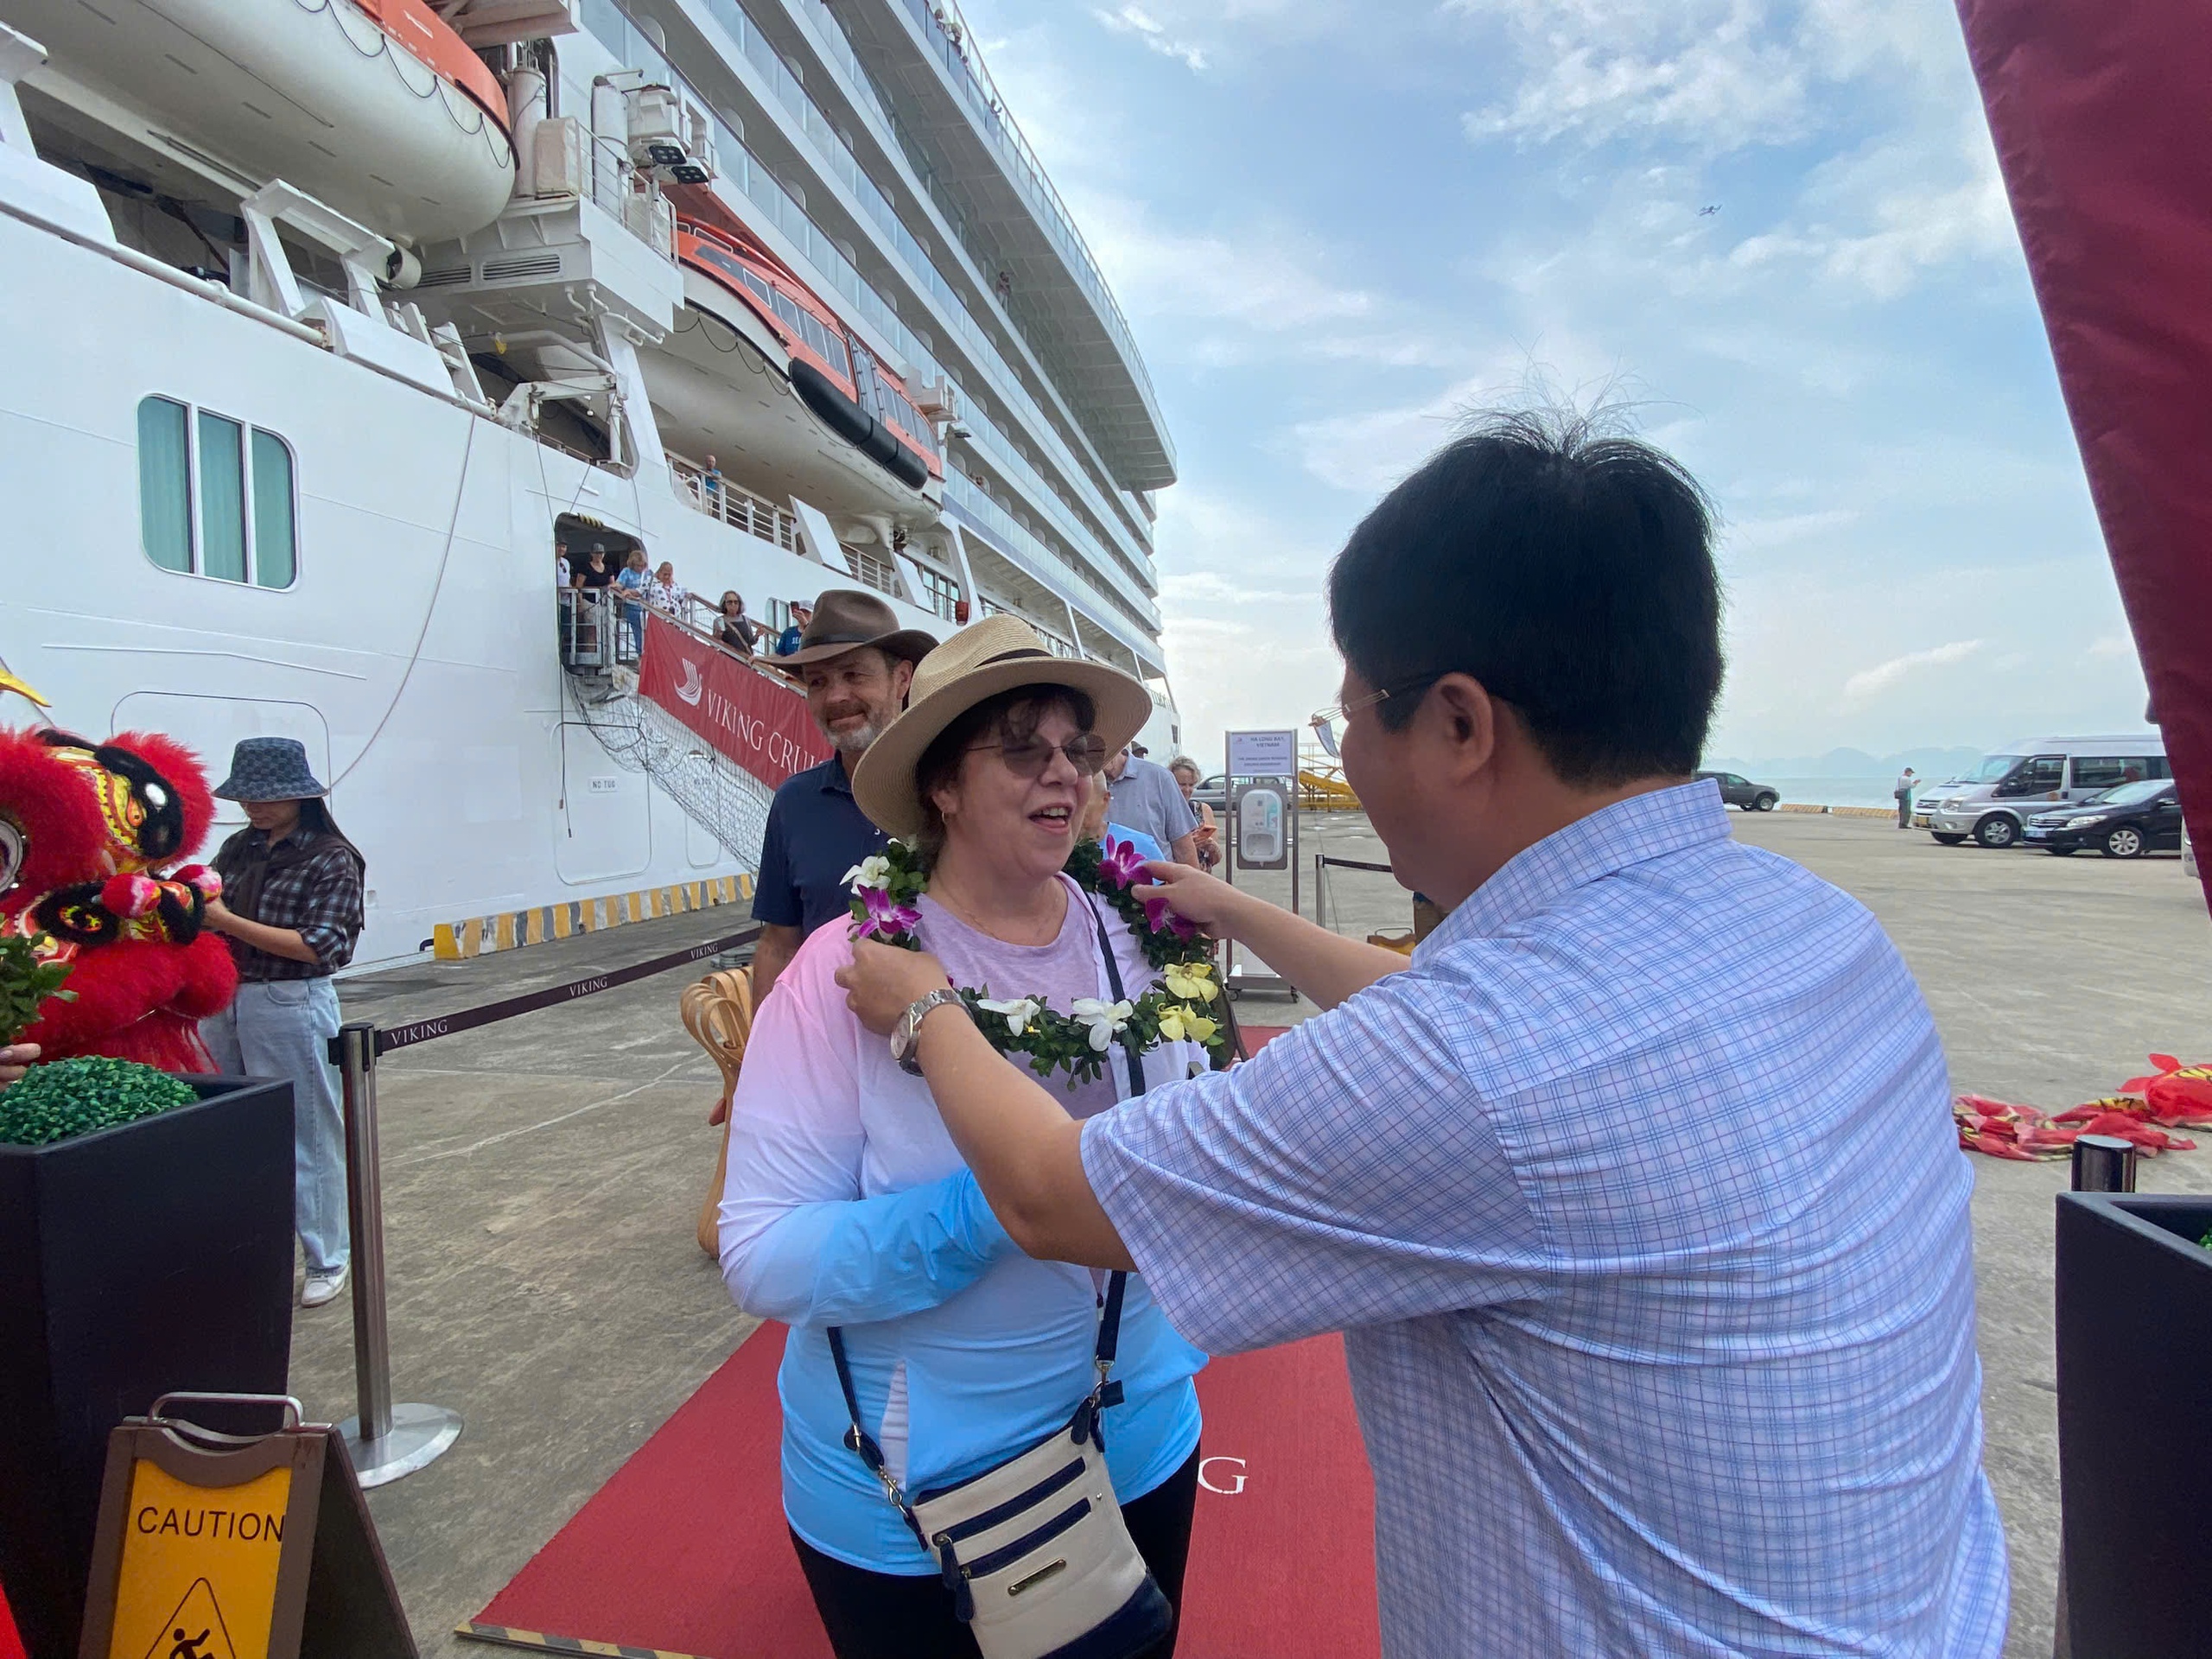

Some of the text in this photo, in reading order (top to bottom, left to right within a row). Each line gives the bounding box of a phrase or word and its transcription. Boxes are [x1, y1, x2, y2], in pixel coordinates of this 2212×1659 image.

[708, 688, 765, 751] VIKING
[690, 943, 719, 960] VIKING
[569, 976, 608, 997] VIKING
[391, 1019, 448, 1046] VIKING
[137, 1506, 286, 1542] CAUTION
